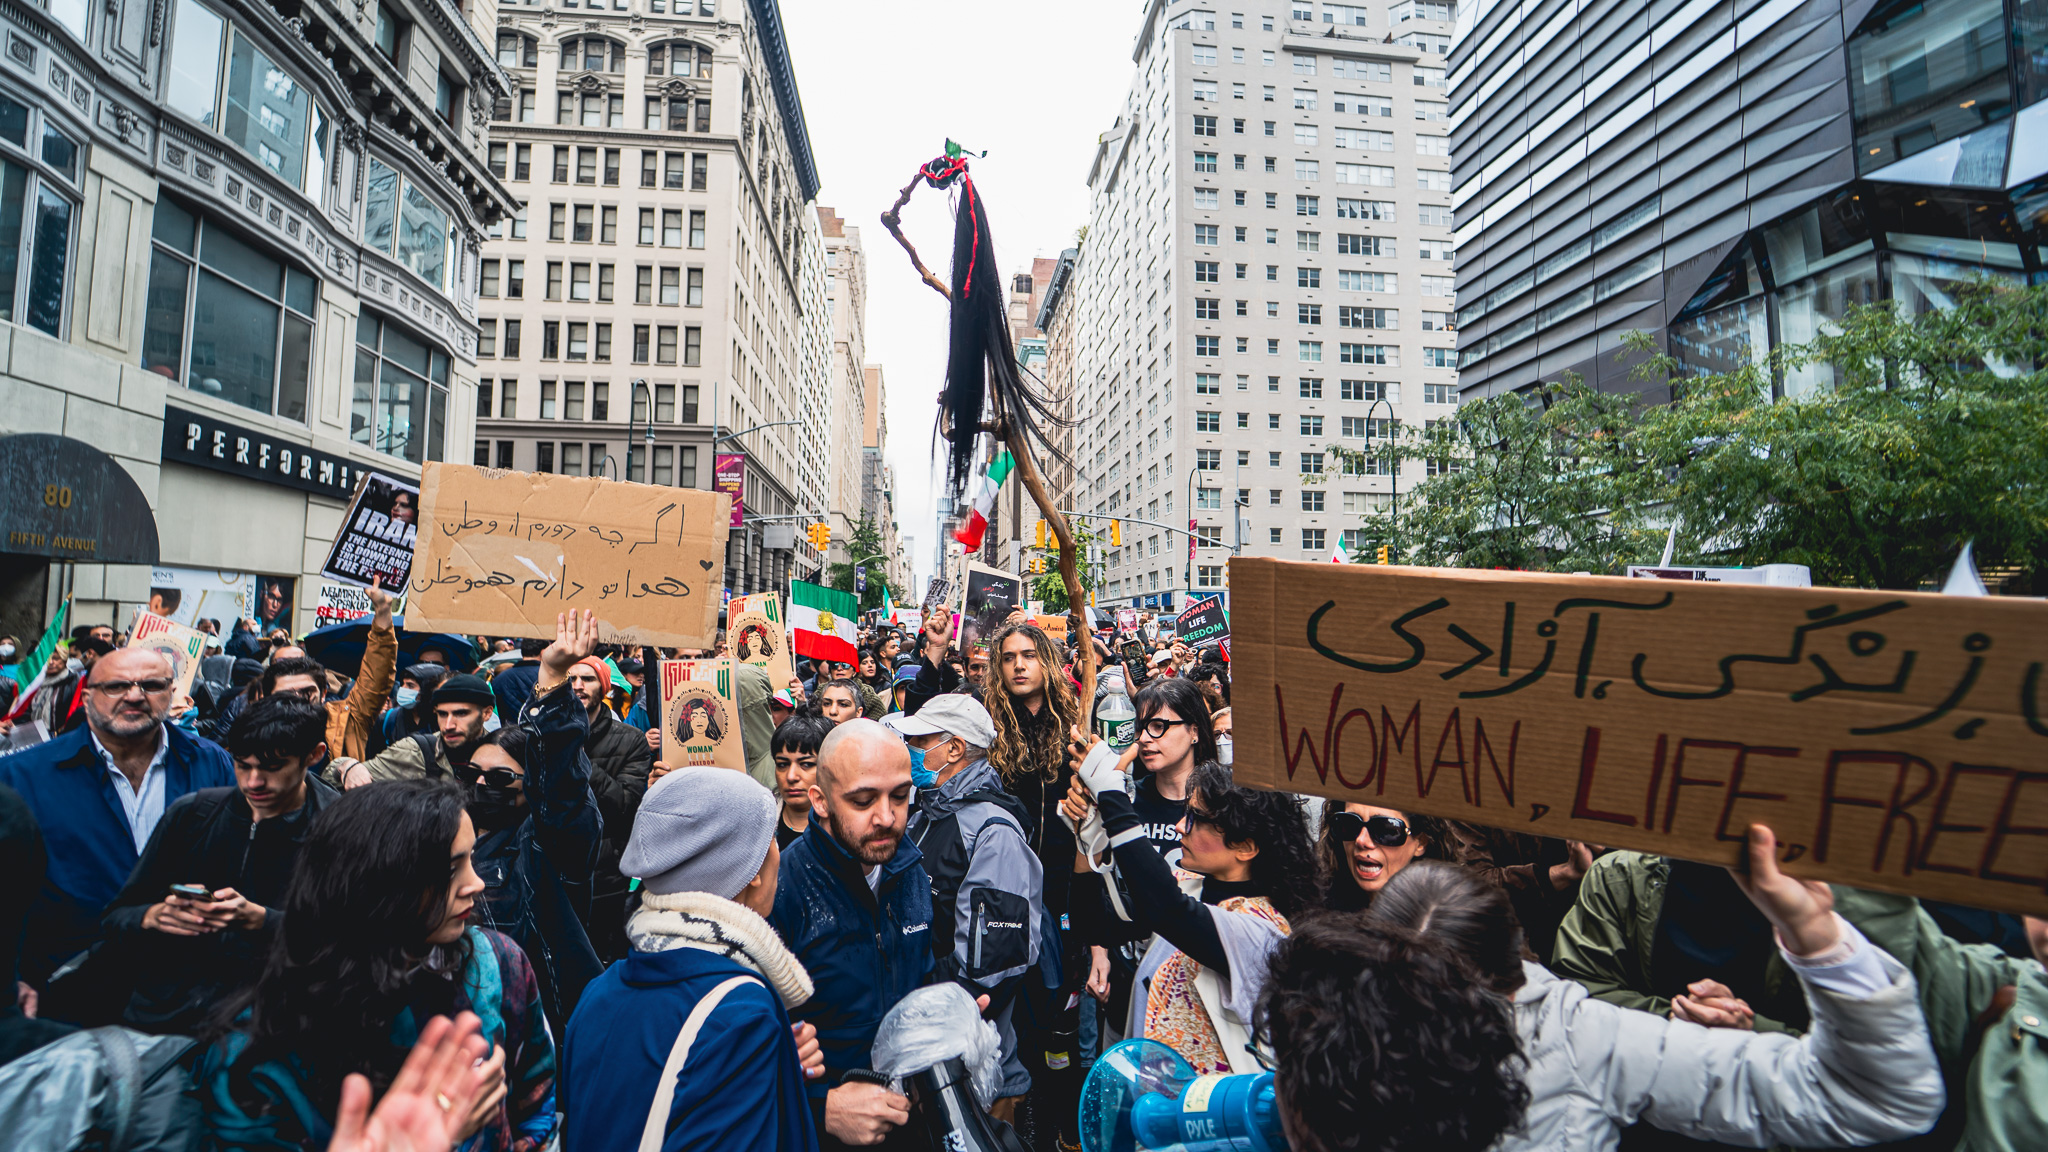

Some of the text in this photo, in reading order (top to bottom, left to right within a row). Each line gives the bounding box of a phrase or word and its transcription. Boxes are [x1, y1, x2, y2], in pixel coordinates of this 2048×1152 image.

[44, 484, 72, 509] 80
[353, 506, 419, 549] IRAN
[442, 500, 499, 537] وطن
[10, 531, 97, 552] FIFTH AVENUE
[347, 532, 414, 562] THE INTERNET
[334, 557, 359, 575] THE
[339, 550, 360, 562] THEY
[359, 556, 376, 568] ARE
[341, 541, 410, 571] IS DOWN AND
[244, 582, 254, 617] ERSACE
[1178, 600, 1215, 624] WOMAN
[1188, 615, 1207, 629] LIFE
[687, 745, 714, 753] WOMAN
[688, 752, 715, 761] LIFE
[1814, 748, 2048, 887] FREE
[1141, 823, 1183, 841] AHS
[1185, 1119, 1217, 1140] PYLE
